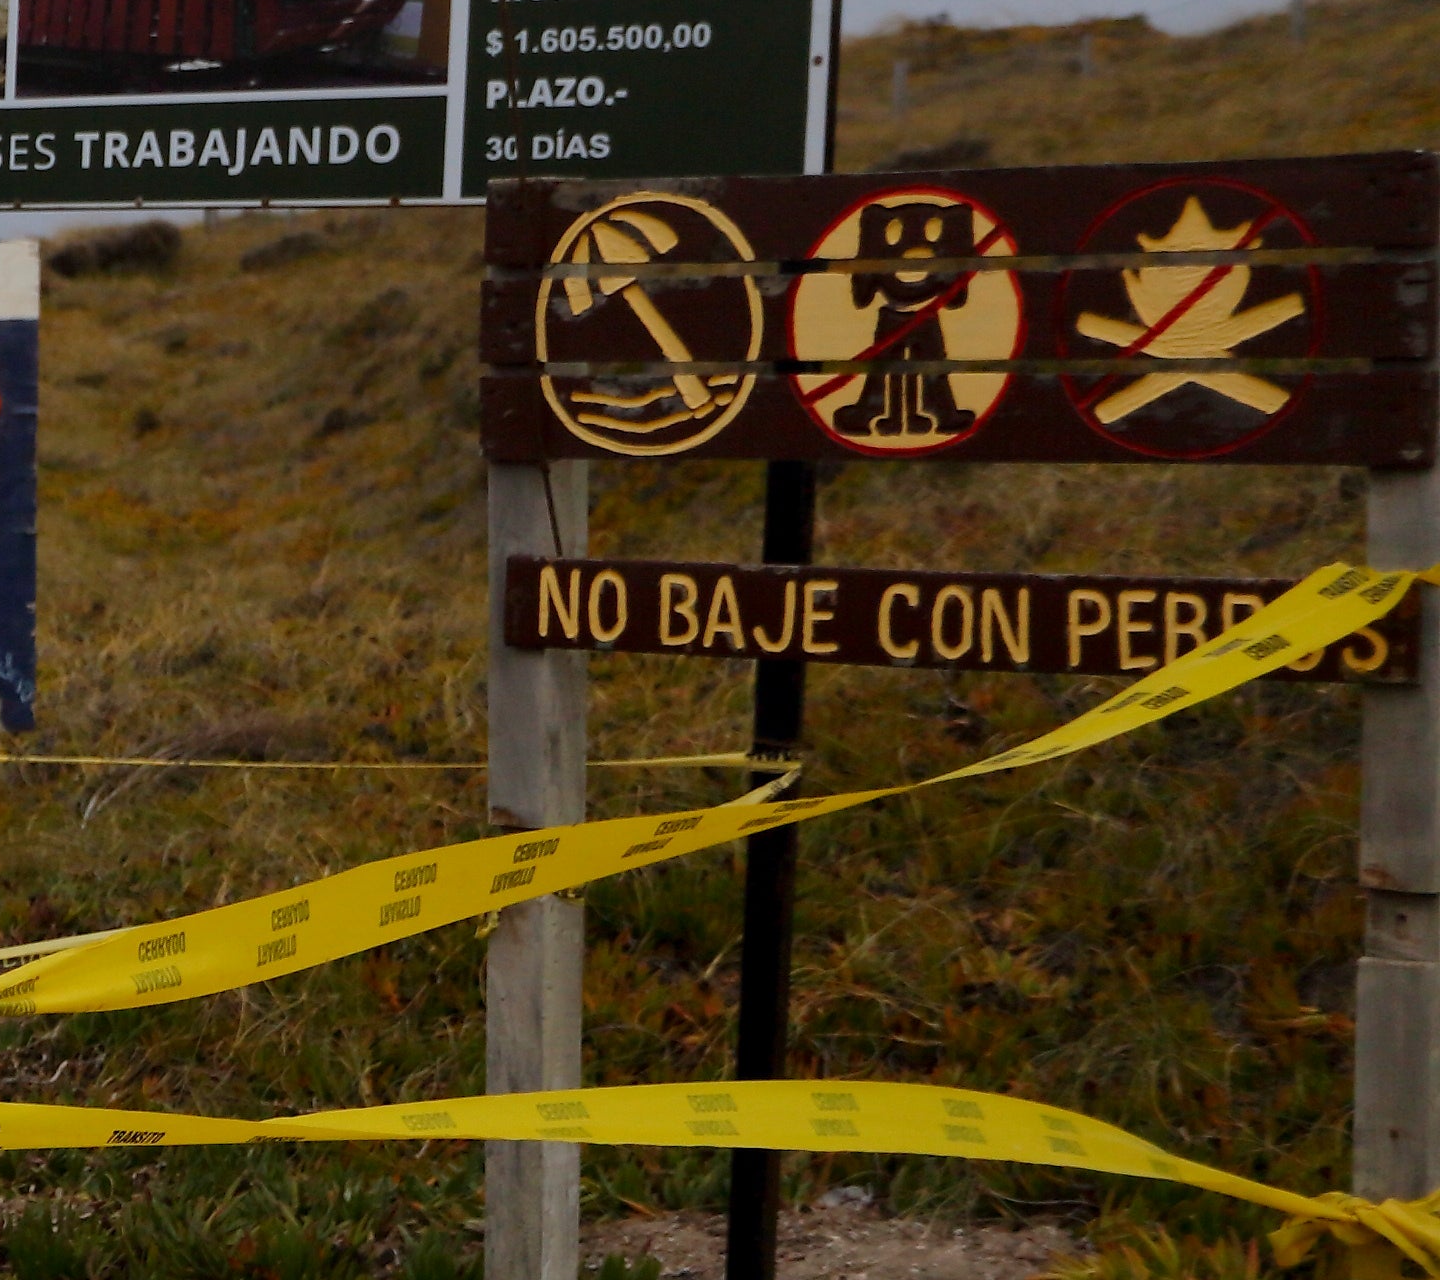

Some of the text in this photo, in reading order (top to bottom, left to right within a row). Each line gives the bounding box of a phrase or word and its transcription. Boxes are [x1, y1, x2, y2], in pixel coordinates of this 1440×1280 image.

[485, 22, 712, 58] $ 1.605.500,00
[75, 123, 401, 177] TRABAJANDO
[532, 127, 611, 161] DÍAS
[537, 565, 628, 645] NO
[659, 573, 841, 655] BAJE
[880, 583, 1031, 666] CON
